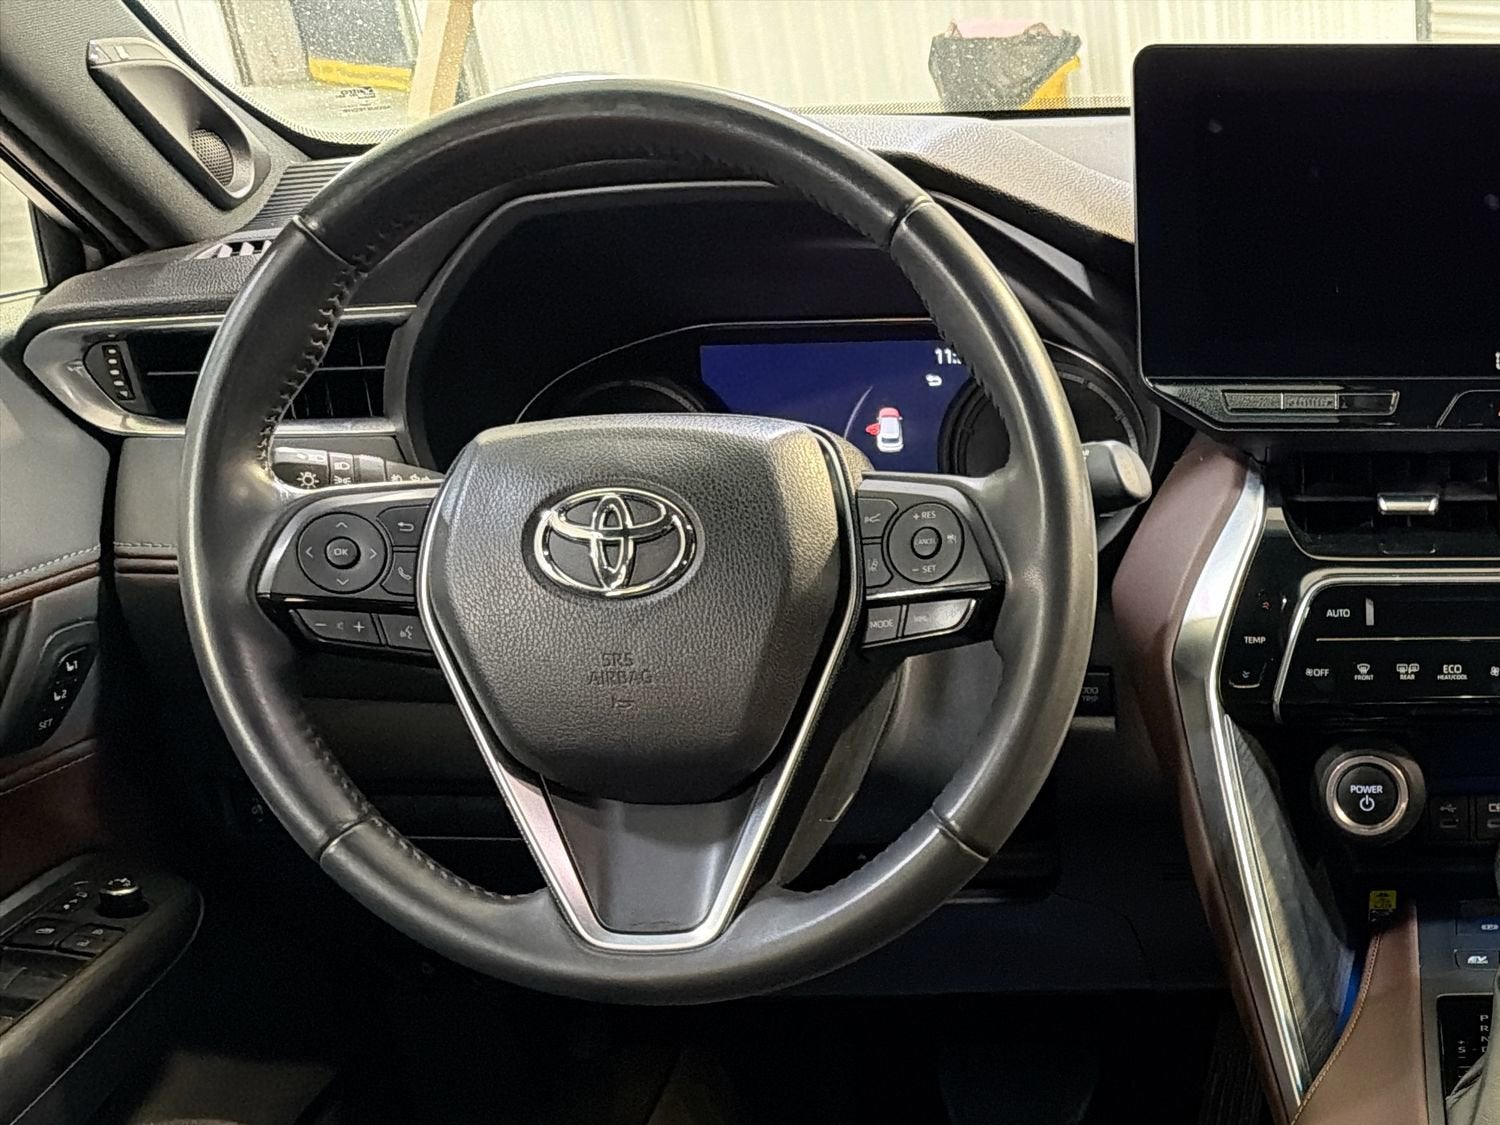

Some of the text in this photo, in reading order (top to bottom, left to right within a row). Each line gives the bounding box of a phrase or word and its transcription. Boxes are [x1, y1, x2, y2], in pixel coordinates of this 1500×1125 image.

[935, 348, 962, 365] 11:
[333, 548, 349, 556] OK
[1326, 608, 1351, 618] AUTO
[869, 619, 894, 629] MODE
[1244, 636, 1266, 645] TEMP
[602, 652, 634, 667] SRS
[1313, 668, 1330, 677] OFF
[1442, 664, 1462, 674] ECO
[587, 670, 654, 684] AIRBAG
[1350, 784, 1384, 794] POWER
[1480, 1014, 1489, 1022] P
